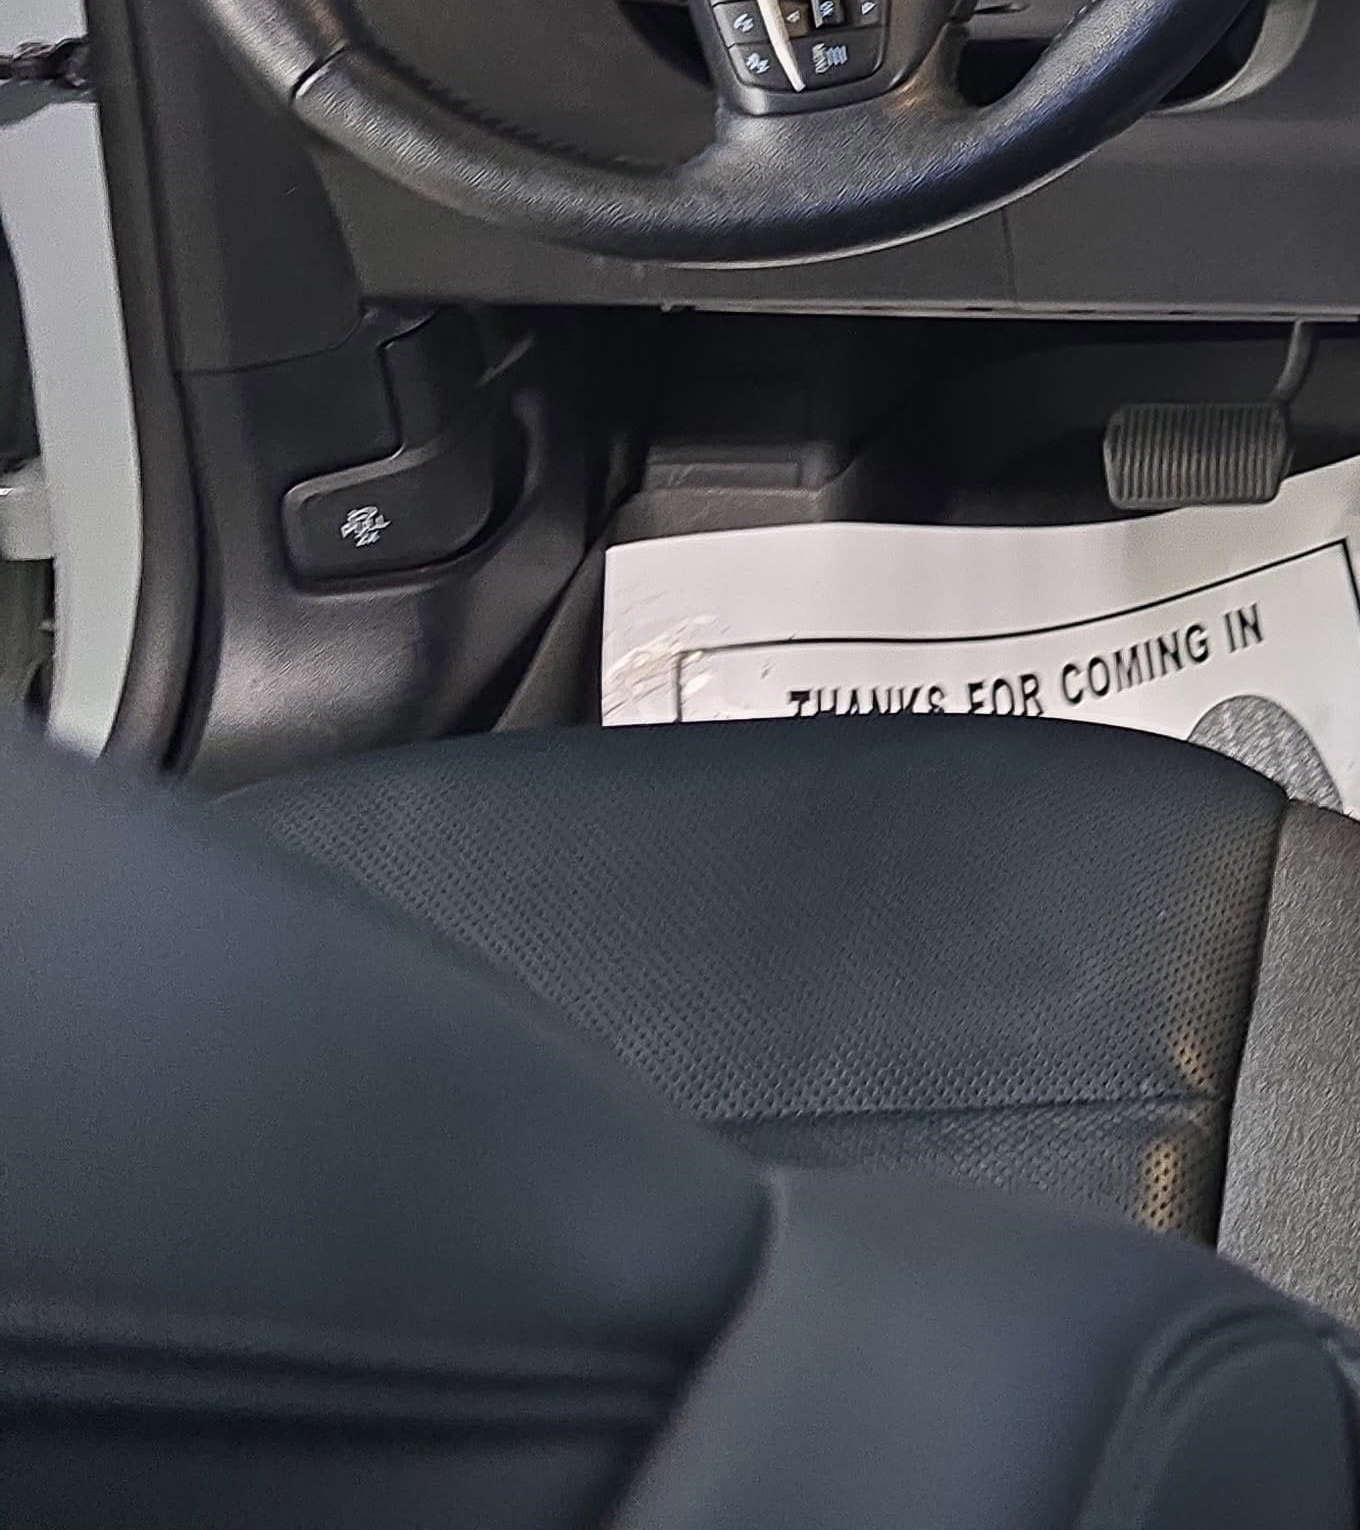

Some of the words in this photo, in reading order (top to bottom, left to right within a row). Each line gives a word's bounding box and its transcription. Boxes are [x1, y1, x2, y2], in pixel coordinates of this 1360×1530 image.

[967, 673, 1044, 716] FOR
[1061, 623, 1209, 706] COMING
[1223, 601, 1265, 654] IN
